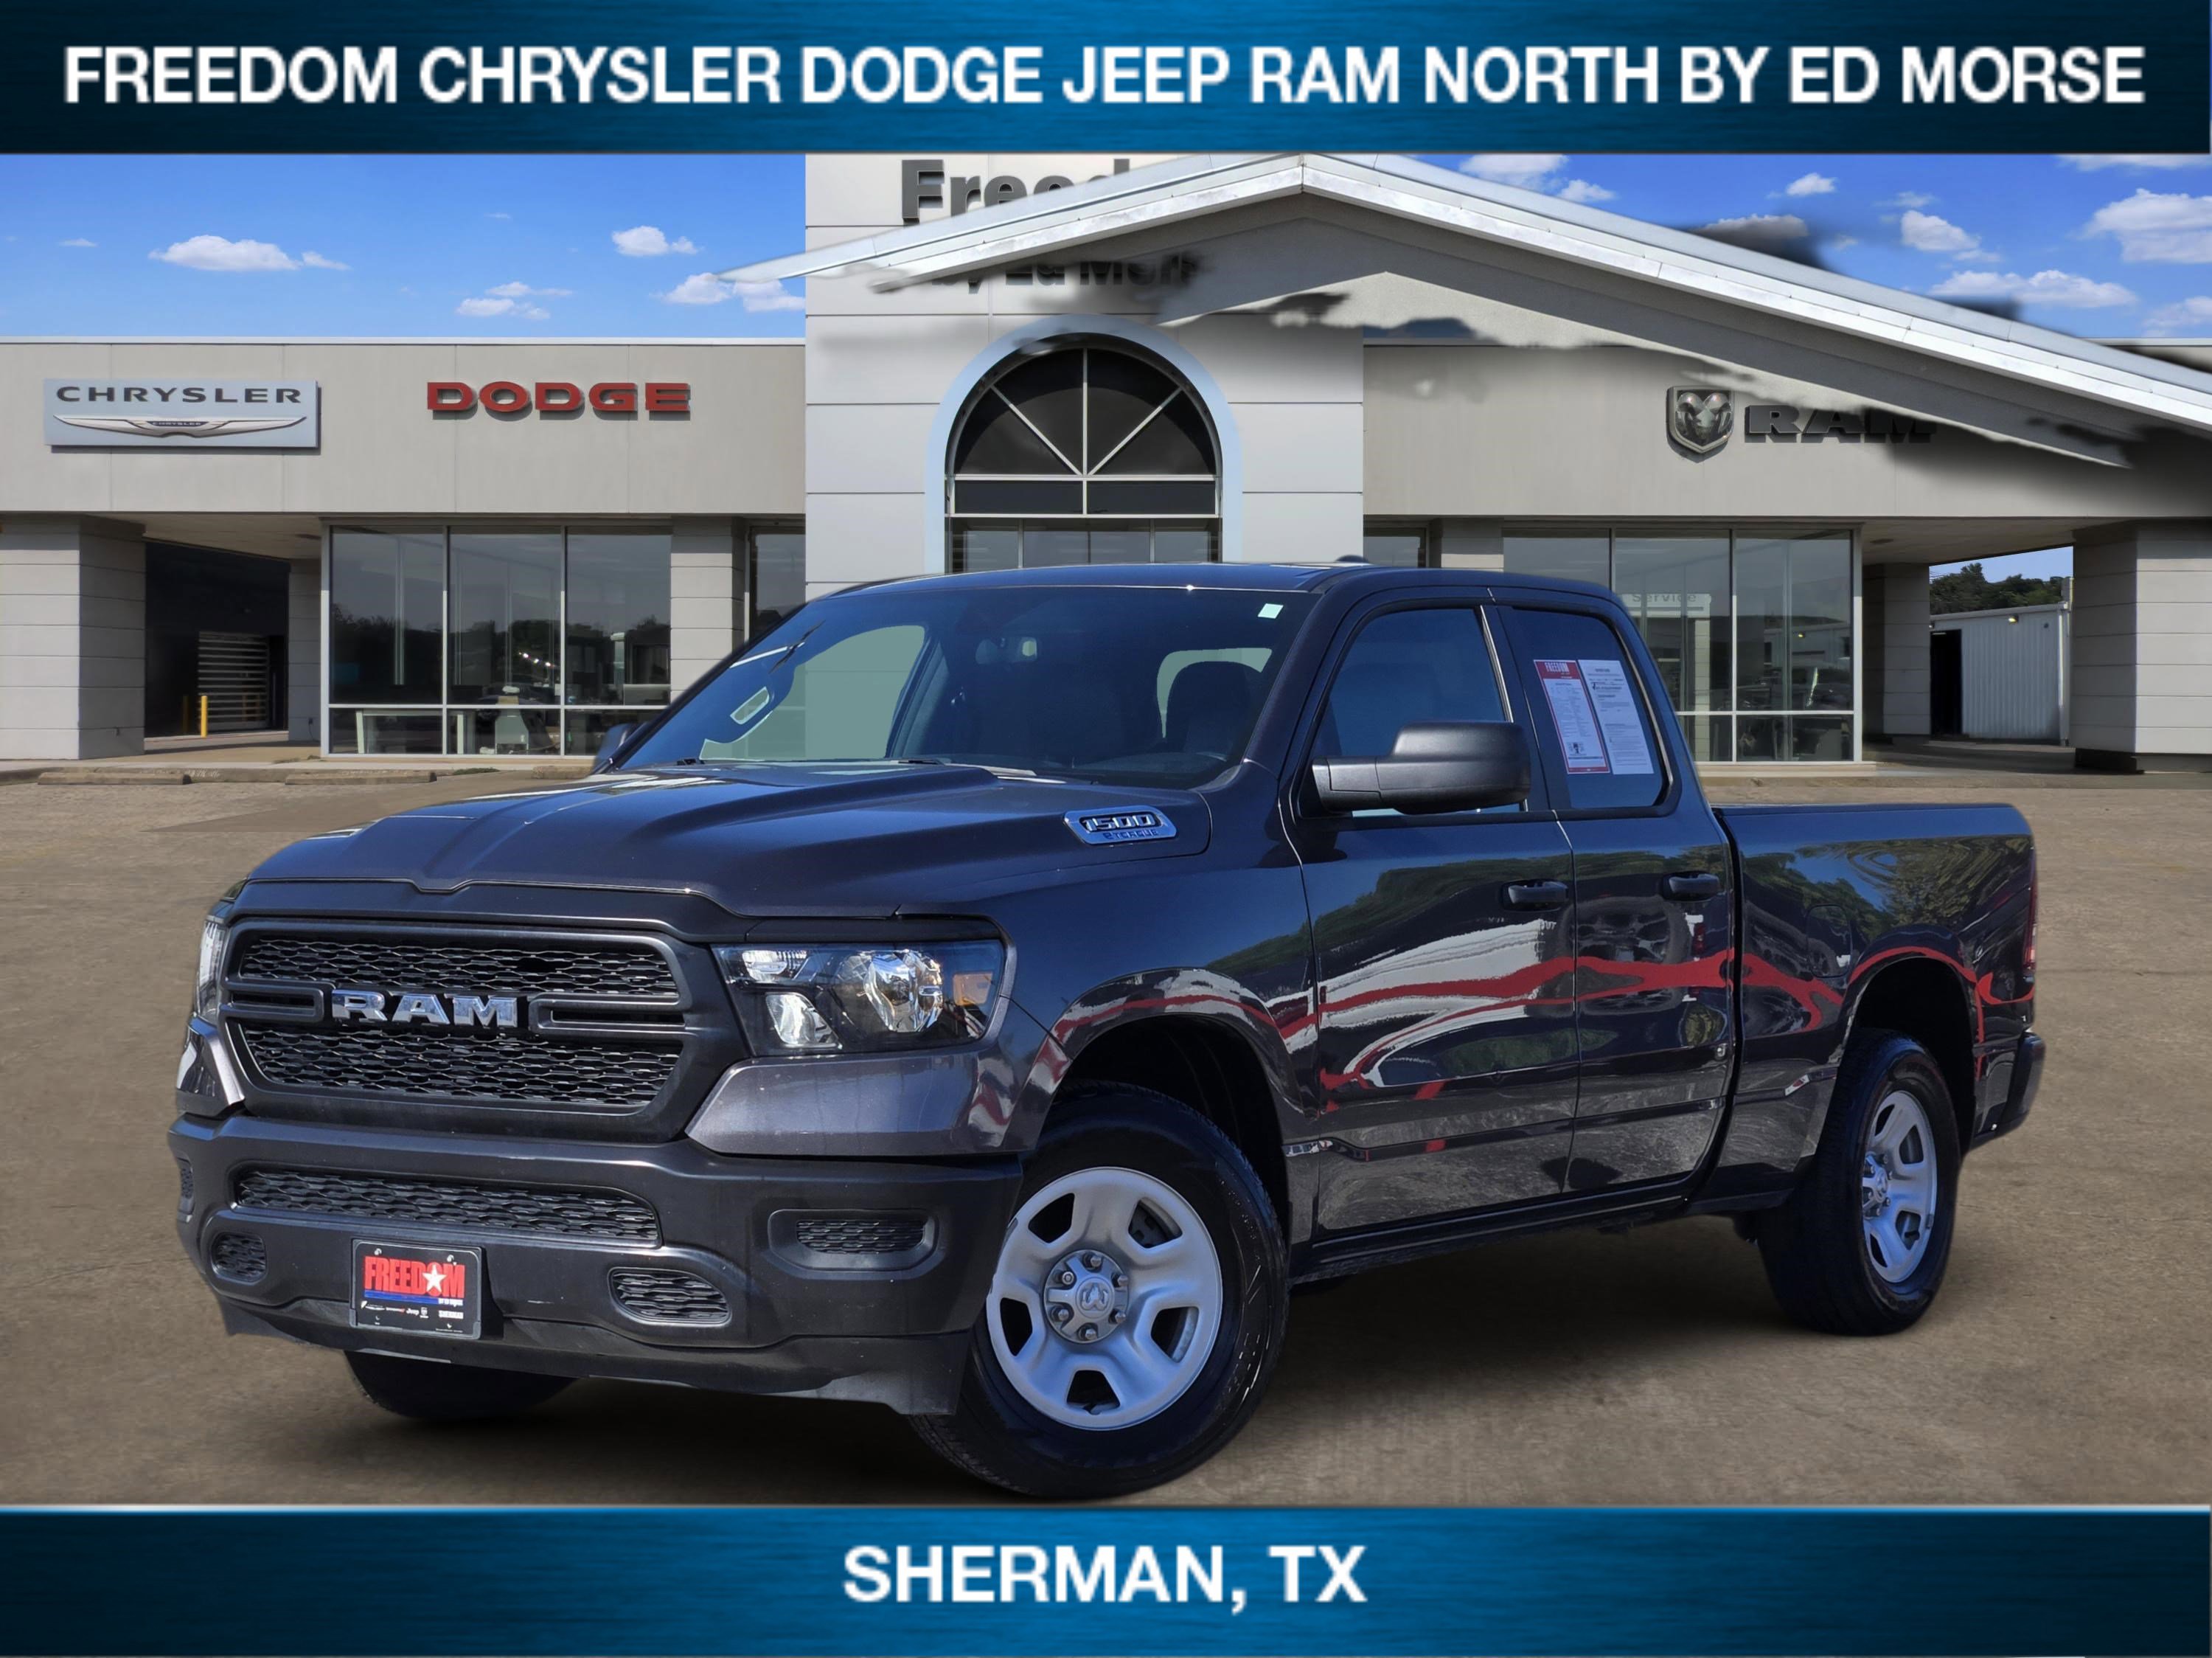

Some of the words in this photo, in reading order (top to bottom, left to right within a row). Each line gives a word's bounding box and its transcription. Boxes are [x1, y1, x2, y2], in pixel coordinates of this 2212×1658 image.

[56, 386, 301, 403] CHRYSLER
[427, 381, 690, 412] DODGE
[1745, 405, 1938, 435] RAM
[1082, 814, 1156, 832] 1500
[332, 989, 518, 1028] RAM
[364, 1256, 466, 1299] FREEDOM
